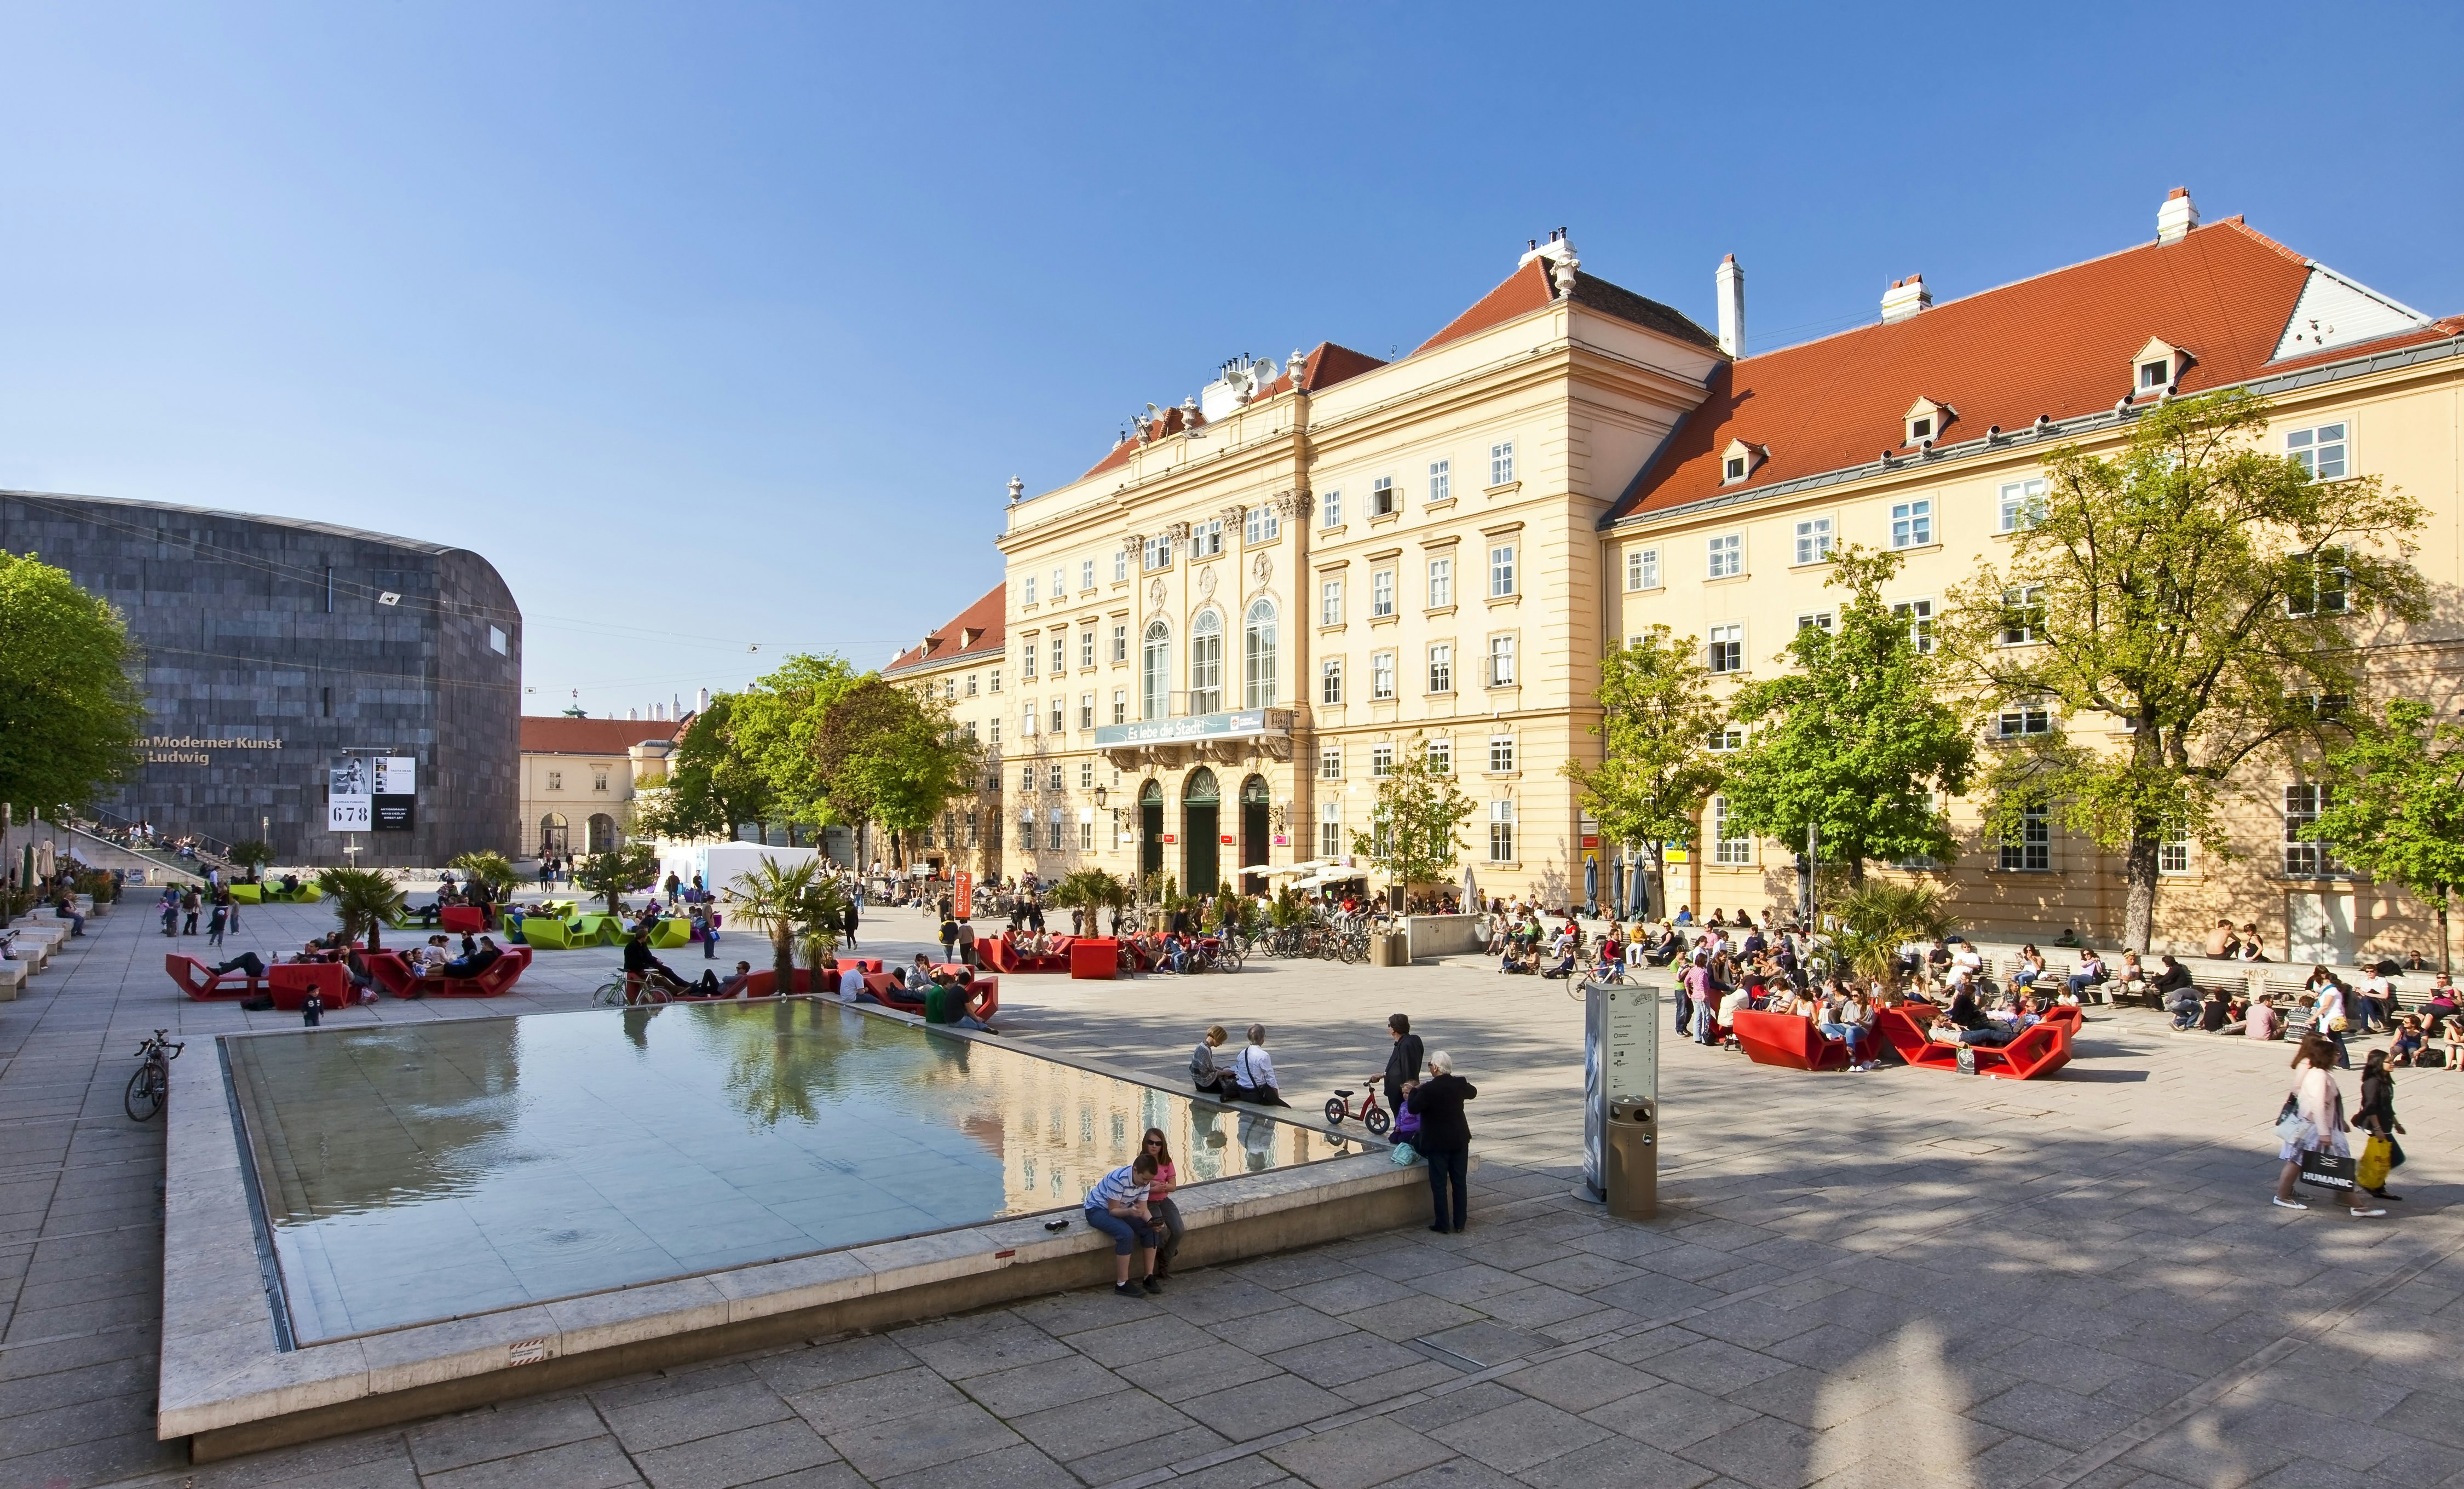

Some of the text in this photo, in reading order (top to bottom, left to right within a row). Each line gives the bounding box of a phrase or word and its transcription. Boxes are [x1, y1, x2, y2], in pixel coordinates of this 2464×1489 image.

[1129, 719, 1205, 740] Es lebe die Stadt!
[154, 736, 234, 748] Moderner
[237, 737, 283, 749] Kunst
[148, 751, 209, 766] Ludwig
[333, 807, 367, 821] 6 7 8
[958, 901, 964, 912] MQ
[2302, 1171, 2353, 1188] HUMANIC
